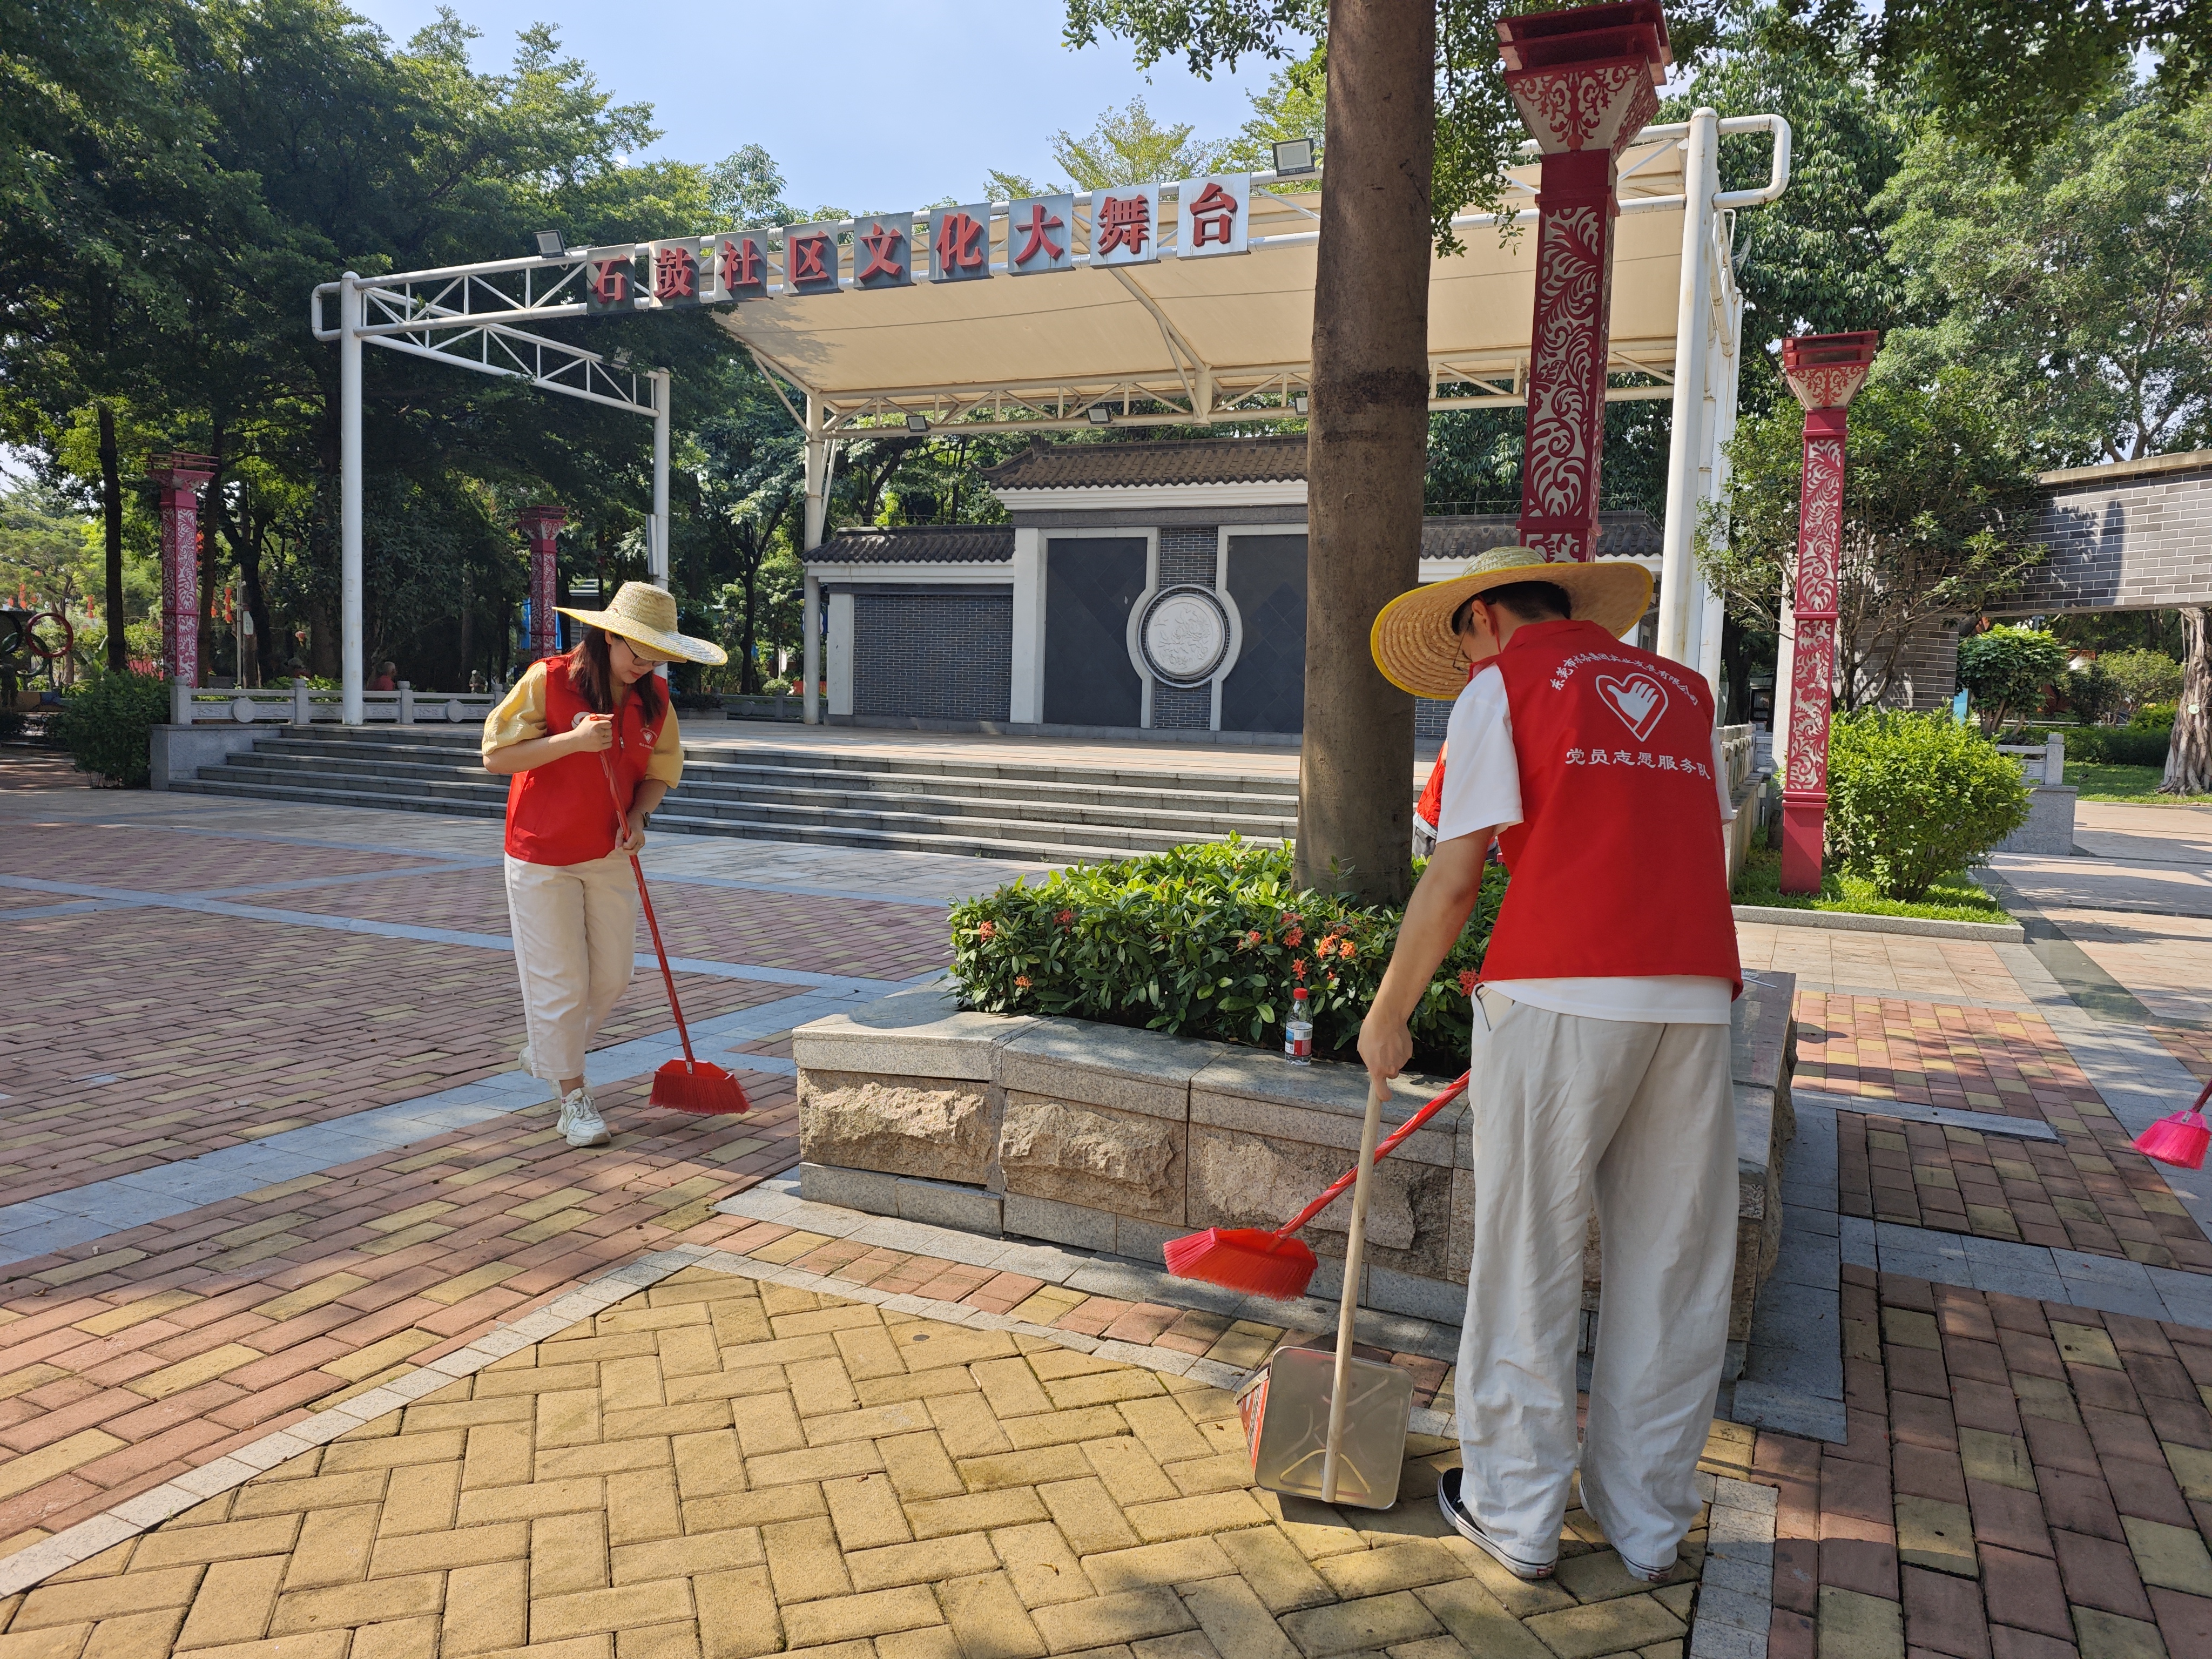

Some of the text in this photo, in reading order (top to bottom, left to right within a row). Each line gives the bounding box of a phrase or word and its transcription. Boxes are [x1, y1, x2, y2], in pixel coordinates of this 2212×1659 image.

[591, 183, 1238, 304] 石鼓社区文化大舞台
[1565, 747, 1711, 780] 党员志愿服务队
